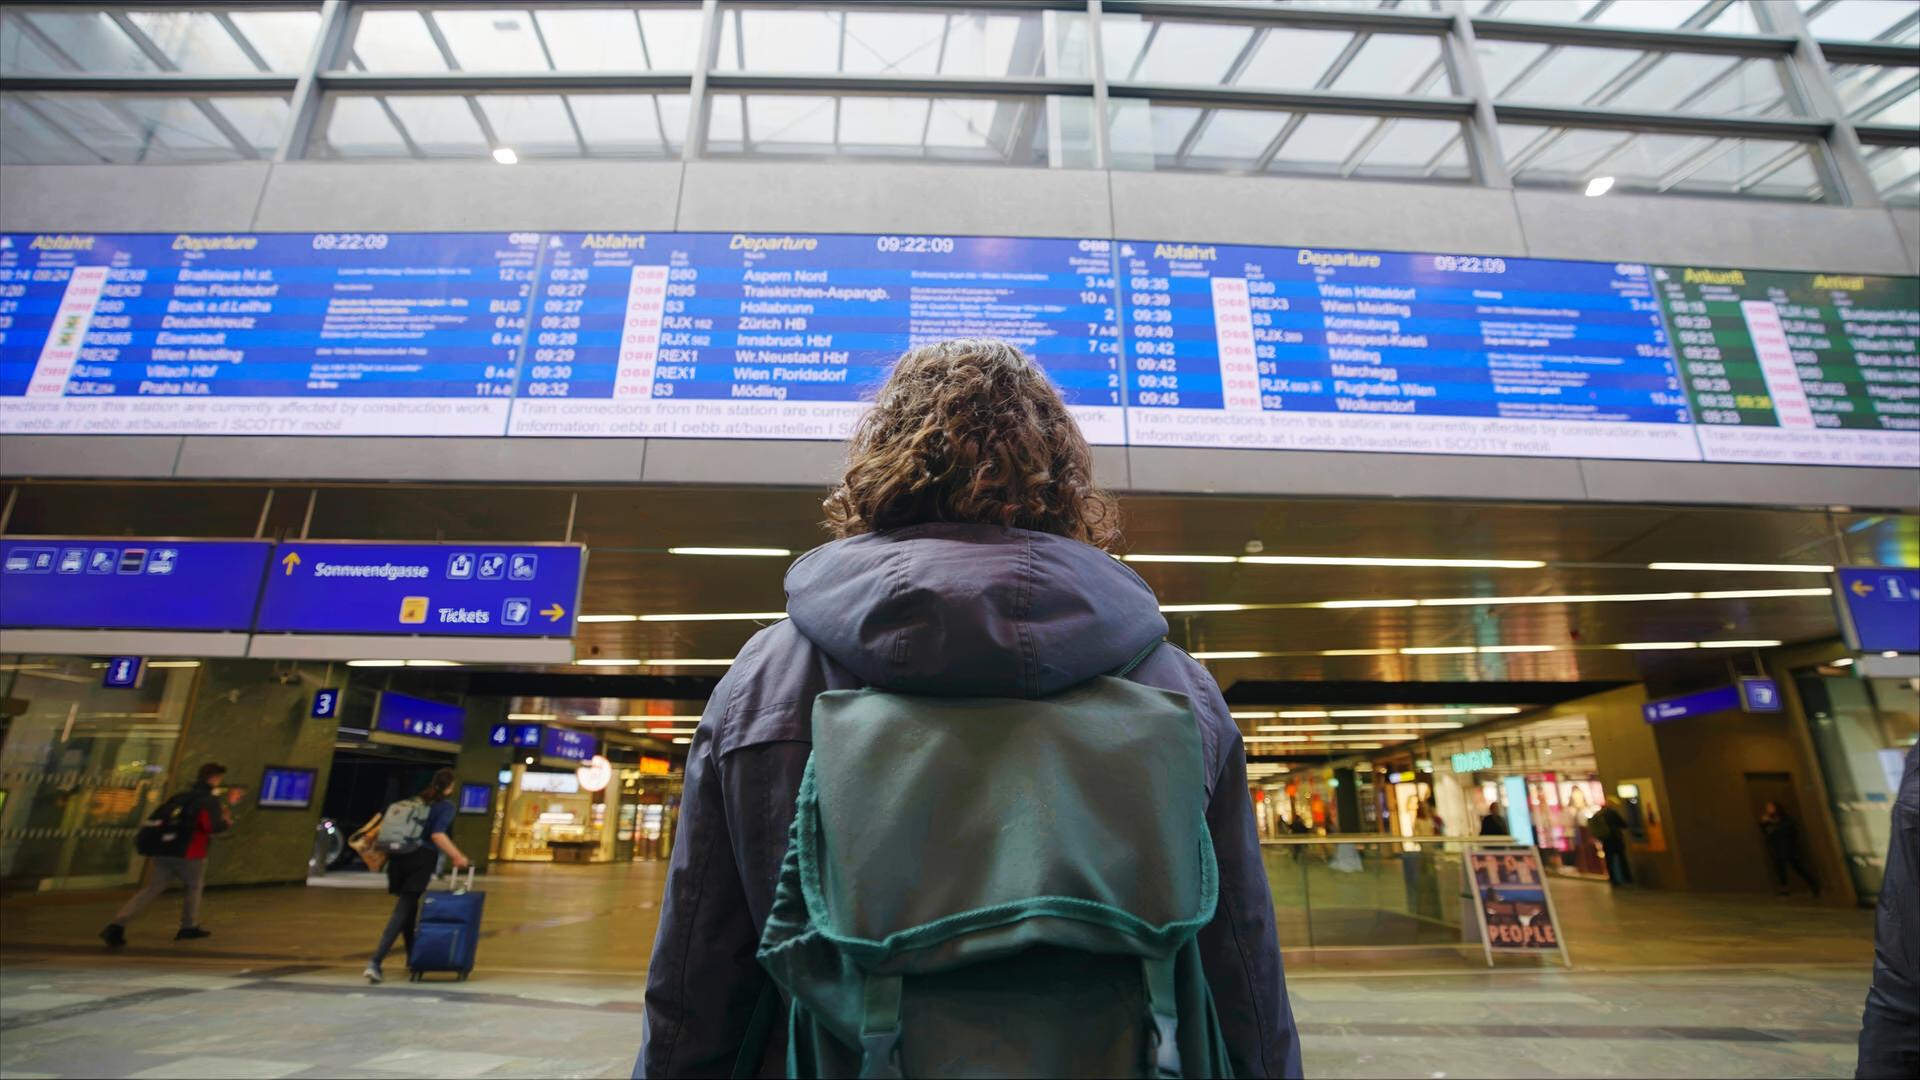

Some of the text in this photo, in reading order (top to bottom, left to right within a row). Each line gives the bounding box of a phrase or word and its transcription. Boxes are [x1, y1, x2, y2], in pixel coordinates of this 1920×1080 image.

[312, 234, 388, 250] 09:22:09
[581, 233, 647, 250] Abfahrt
[729, 234, 818, 251] Departure
[877, 236, 954, 252] 09:22:09
[1153, 244, 1506, 274] Abfahrt Departure 09:22:09
[744, 270, 791, 284] Aspern
[794, 270, 827, 282] Nord
[1080, 292, 1097, 304] 10
[740, 302, 814, 315] Hollabrunn
[738, 317, 782, 330] Zürich
[737, 334, 803, 347] Innsbruck
[806, 334, 832, 347] Hbf
[823, 351, 849, 364] Hbf
[655, 367, 696, 379] REX1
[734, 367, 769, 381] Wien
[773, 367, 848, 382] Floridsdorf
[520, 402, 558, 416] Train
[560, 403, 653, 417] connections
[313, 562, 430, 582] Sonnwendgasse
[438, 607, 490, 624] Tickets
[317, 693, 332, 715] 3
[493, 726, 506, 744] 4
[1488, 924, 1556, 945] PEOPLE
